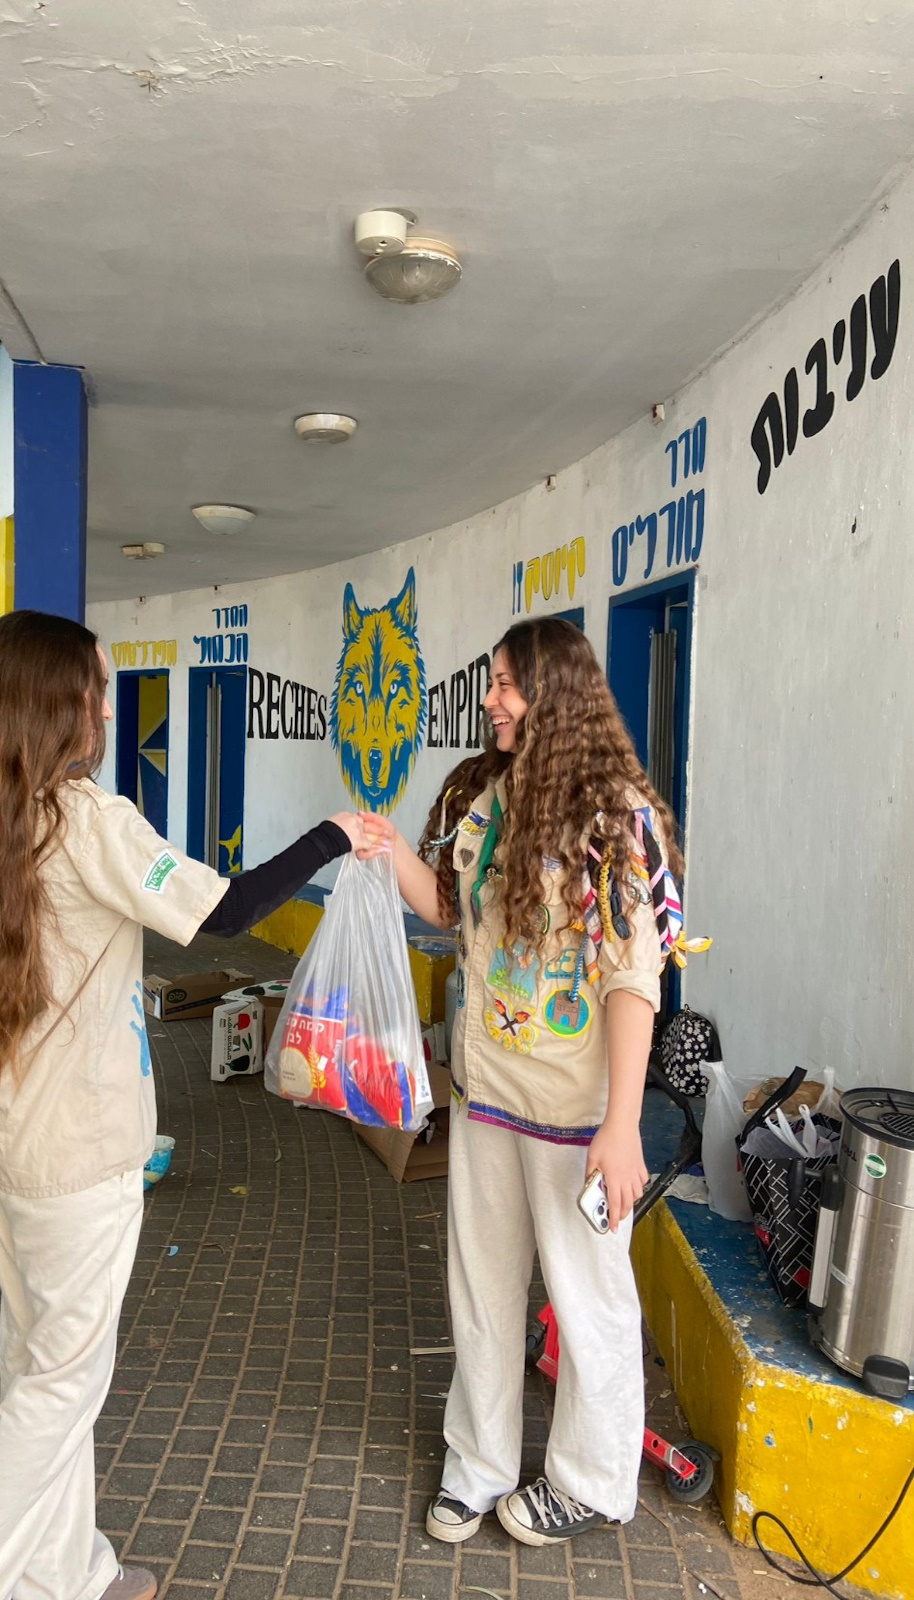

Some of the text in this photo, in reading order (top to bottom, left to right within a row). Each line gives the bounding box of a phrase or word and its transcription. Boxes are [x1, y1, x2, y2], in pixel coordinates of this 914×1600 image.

[751, 259, 900, 495] עניבות
[665, 417, 706, 487] חדר
[525, 536, 586, 614] קיוסק
[612, 489, 705, 586] מורלים
[193, 633, 249, 664] הכחול
[212, 604, 248, 629] החדר
[247, 651, 493, 749] RECHES EMPIR
